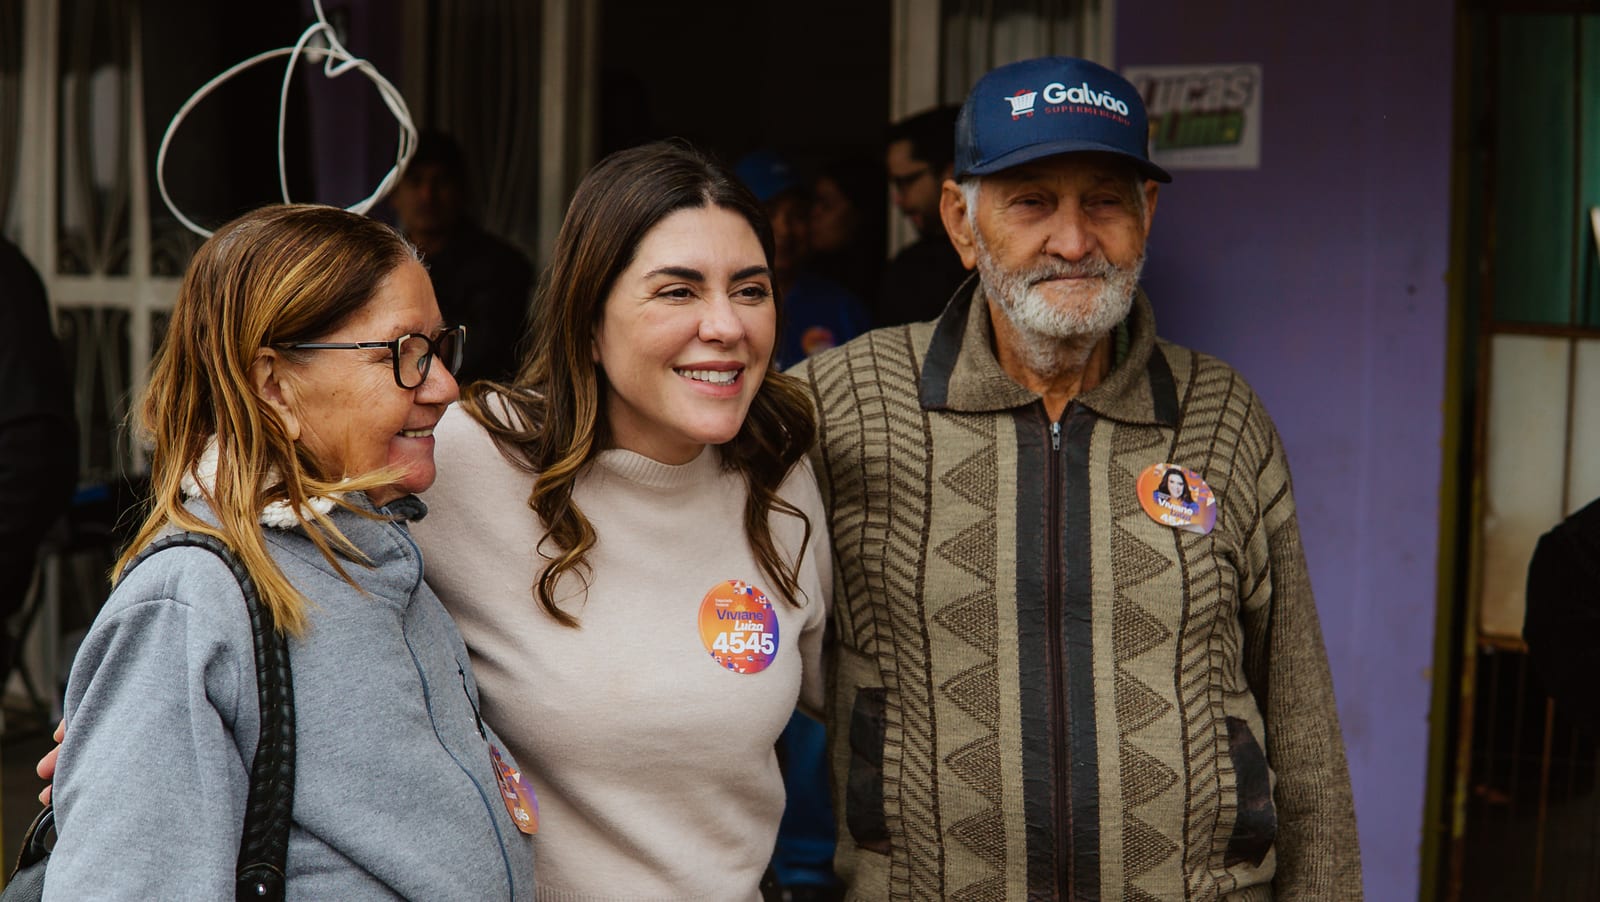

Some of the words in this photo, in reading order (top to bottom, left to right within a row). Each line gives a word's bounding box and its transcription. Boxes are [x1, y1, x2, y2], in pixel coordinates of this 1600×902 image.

[1042, 82, 1129, 116] Galvão
[1044, 105, 1131, 126] SUPERMERCADO
[716, 609, 764, 621] Viviane
[734, 620, 764, 632] Luiza
[712, 631, 775, 655] 4545
